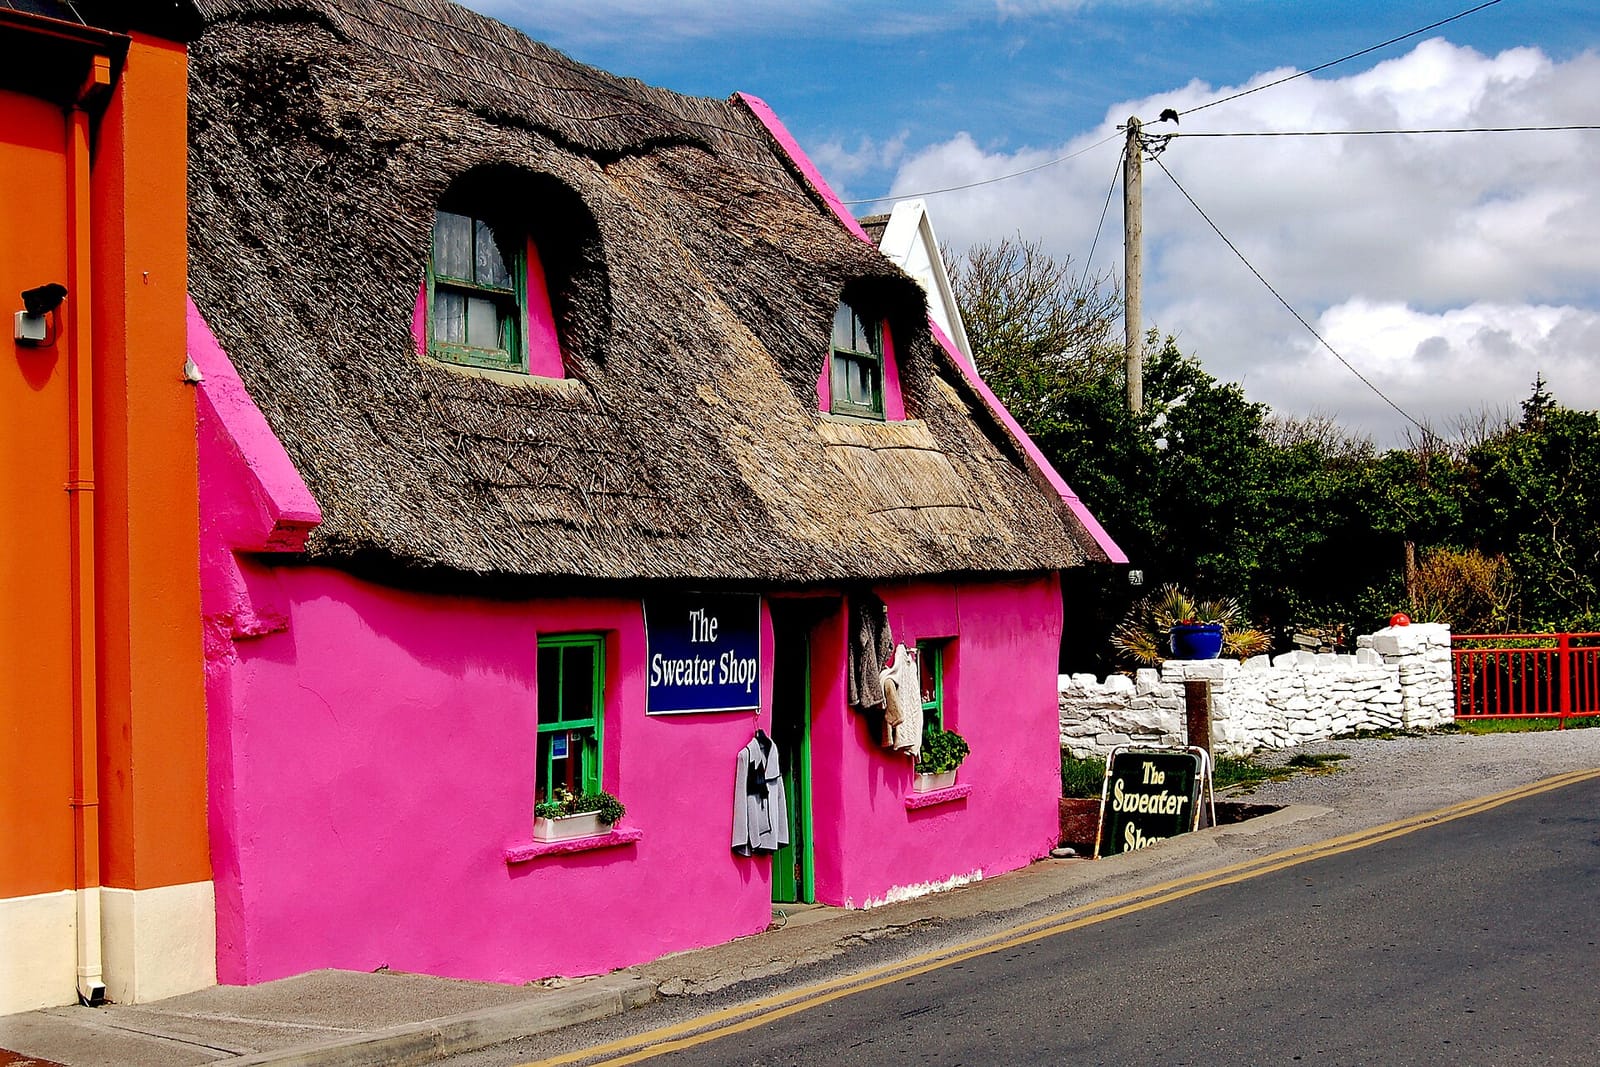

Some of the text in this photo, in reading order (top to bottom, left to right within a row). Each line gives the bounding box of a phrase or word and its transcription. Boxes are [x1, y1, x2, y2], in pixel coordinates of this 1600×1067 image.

[689, 608, 718, 642] The
[650, 649, 757, 693] Sweater Shop
[1142, 761, 1165, 785] The
[1112, 778, 1188, 815] Sweater
